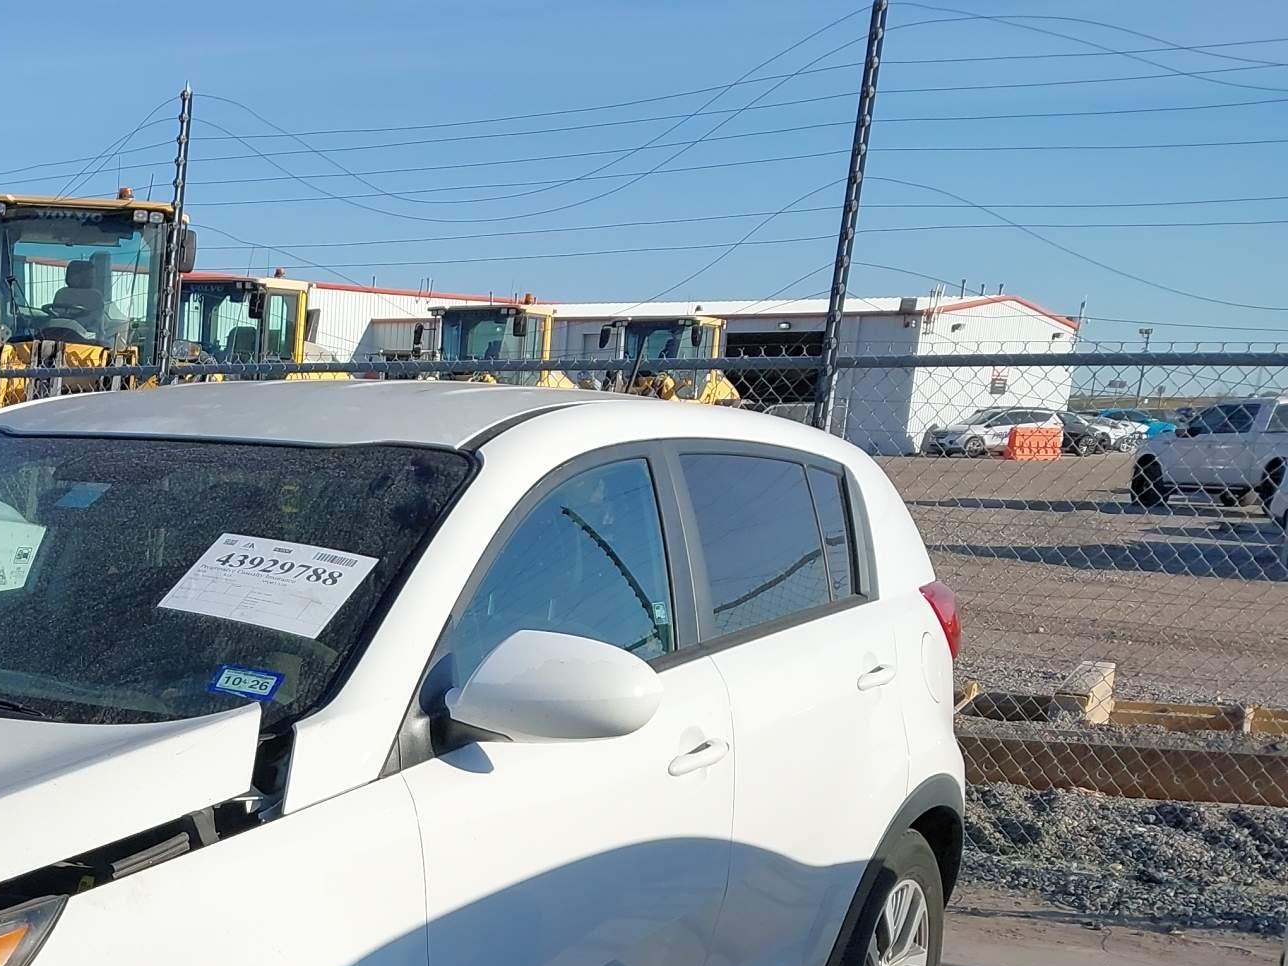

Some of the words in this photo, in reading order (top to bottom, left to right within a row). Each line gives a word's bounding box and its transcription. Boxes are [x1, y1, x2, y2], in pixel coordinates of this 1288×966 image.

[215, 552, 344, 586] 43929788
[224, 676, 243, 686] 10
[248, 680, 270, 691] 26
